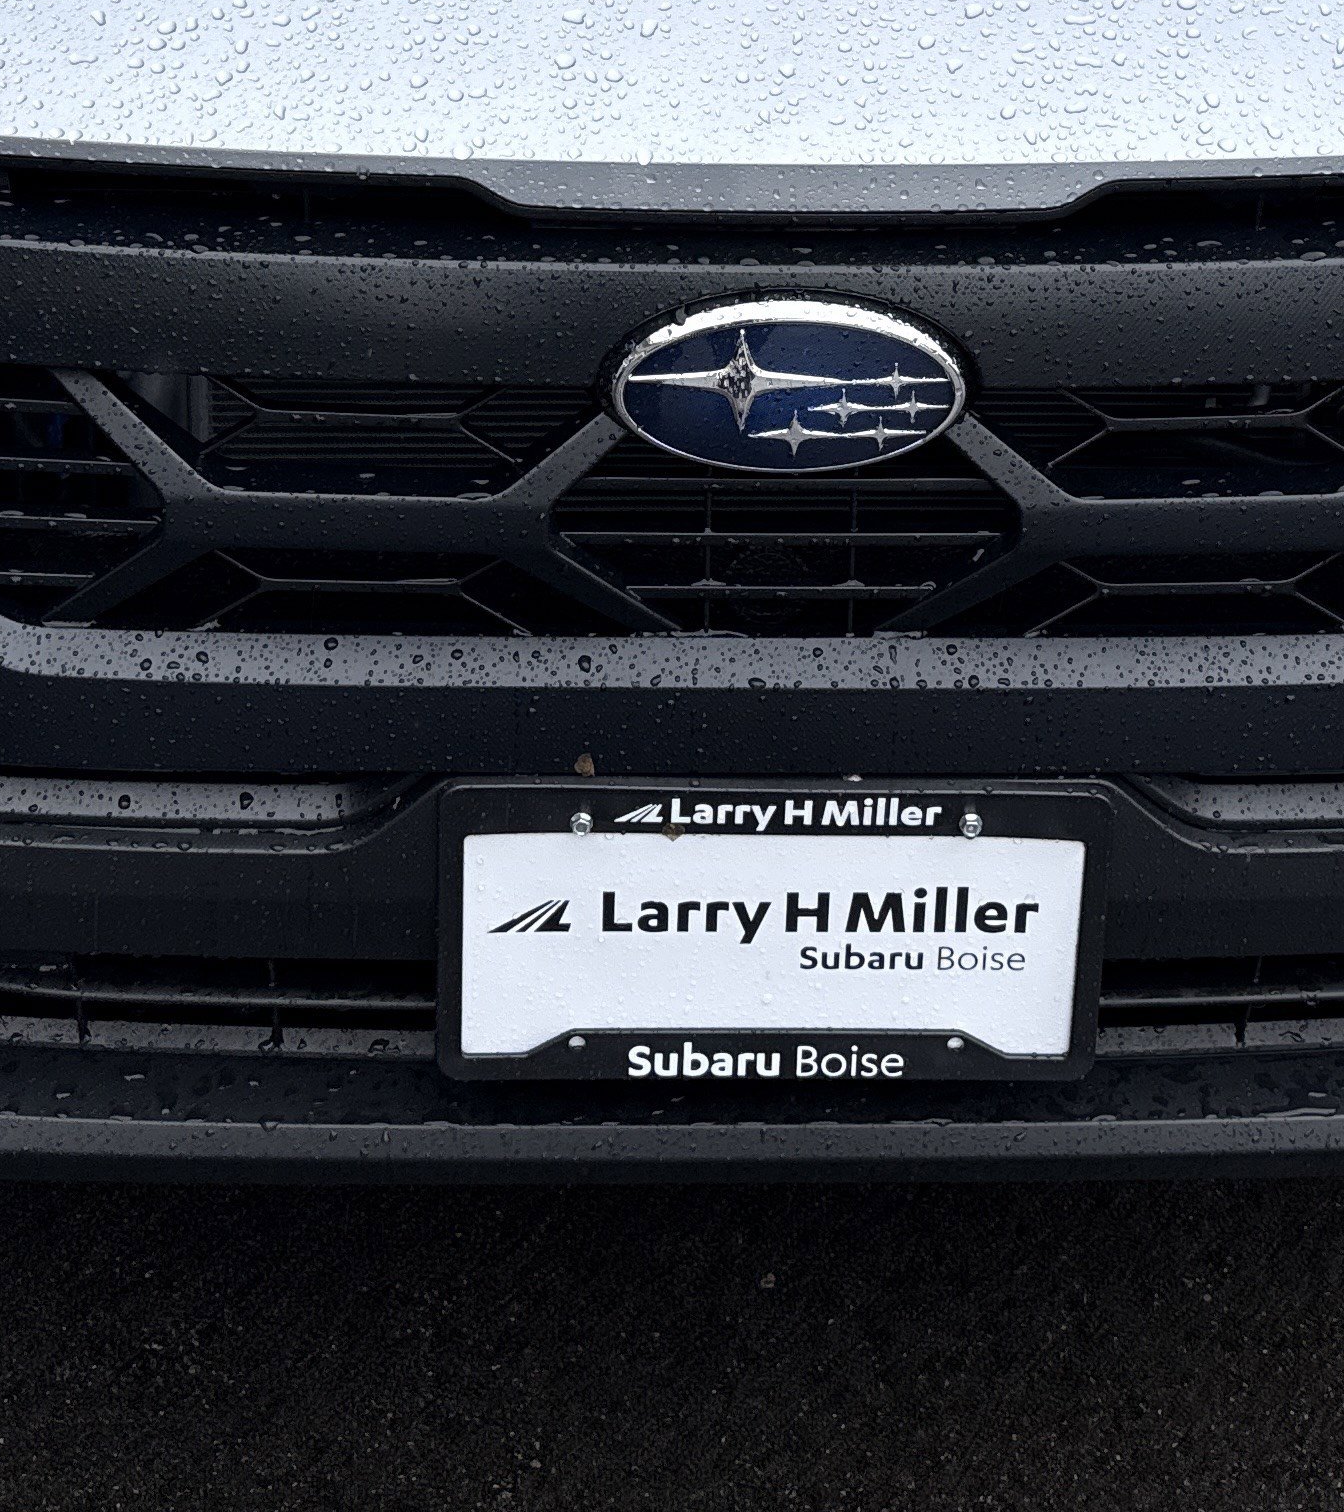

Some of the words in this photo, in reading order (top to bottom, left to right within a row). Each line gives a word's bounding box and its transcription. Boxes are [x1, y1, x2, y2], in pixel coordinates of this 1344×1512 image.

[670, 798, 777, 832] Larry
[784, 799, 814, 826] H
[821, 798, 943, 826] Miller
[601, 890, 772, 944] Larry
[785, 891, 831, 933] H
[845, 886, 1040, 934] Miller
[799, 944, 925, 971] Subaru
[936, 945, 1027, 972] Boise
[627, 1041, 781, 1077] Subaru
[795, 1044, 905, 1077] Boise
